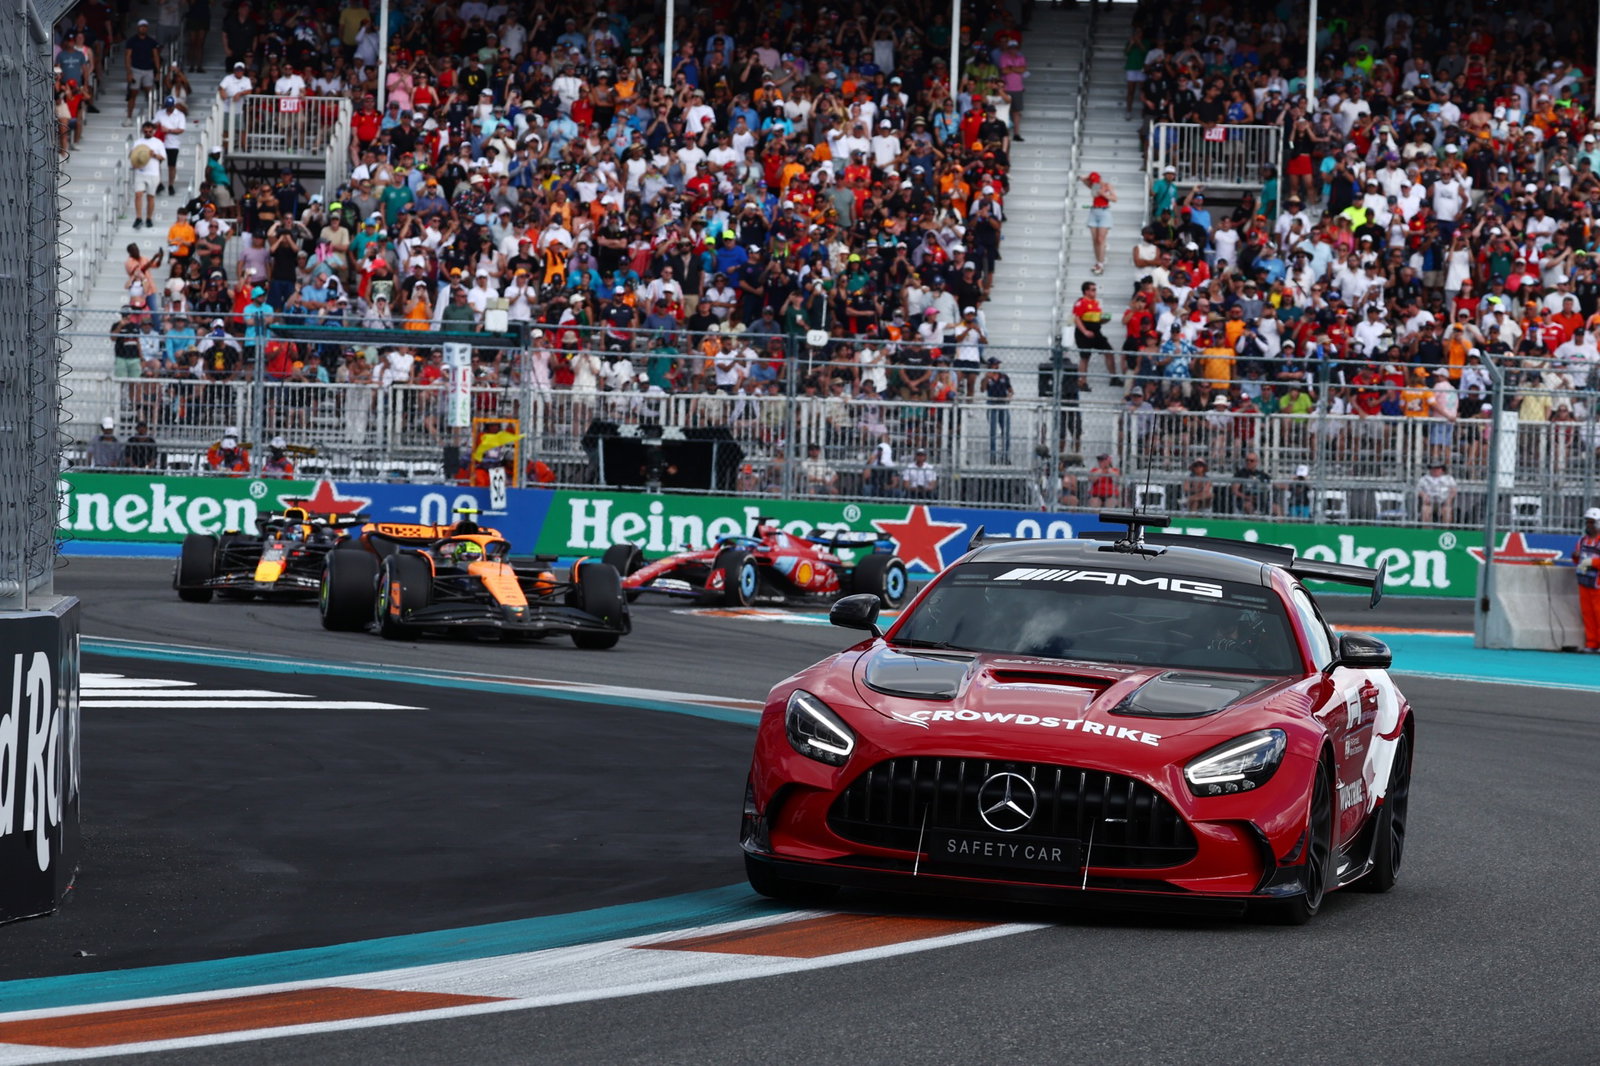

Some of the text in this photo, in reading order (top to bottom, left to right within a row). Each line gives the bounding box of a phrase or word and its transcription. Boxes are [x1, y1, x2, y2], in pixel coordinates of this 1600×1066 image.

[57, 478, 260, 536] ineken
[1063, 570, 1223, 598] AMG
[906, 709, 1162, 747] CROWDSTRIKE
[947, 839, 1062, 862] SAFETY CAR
